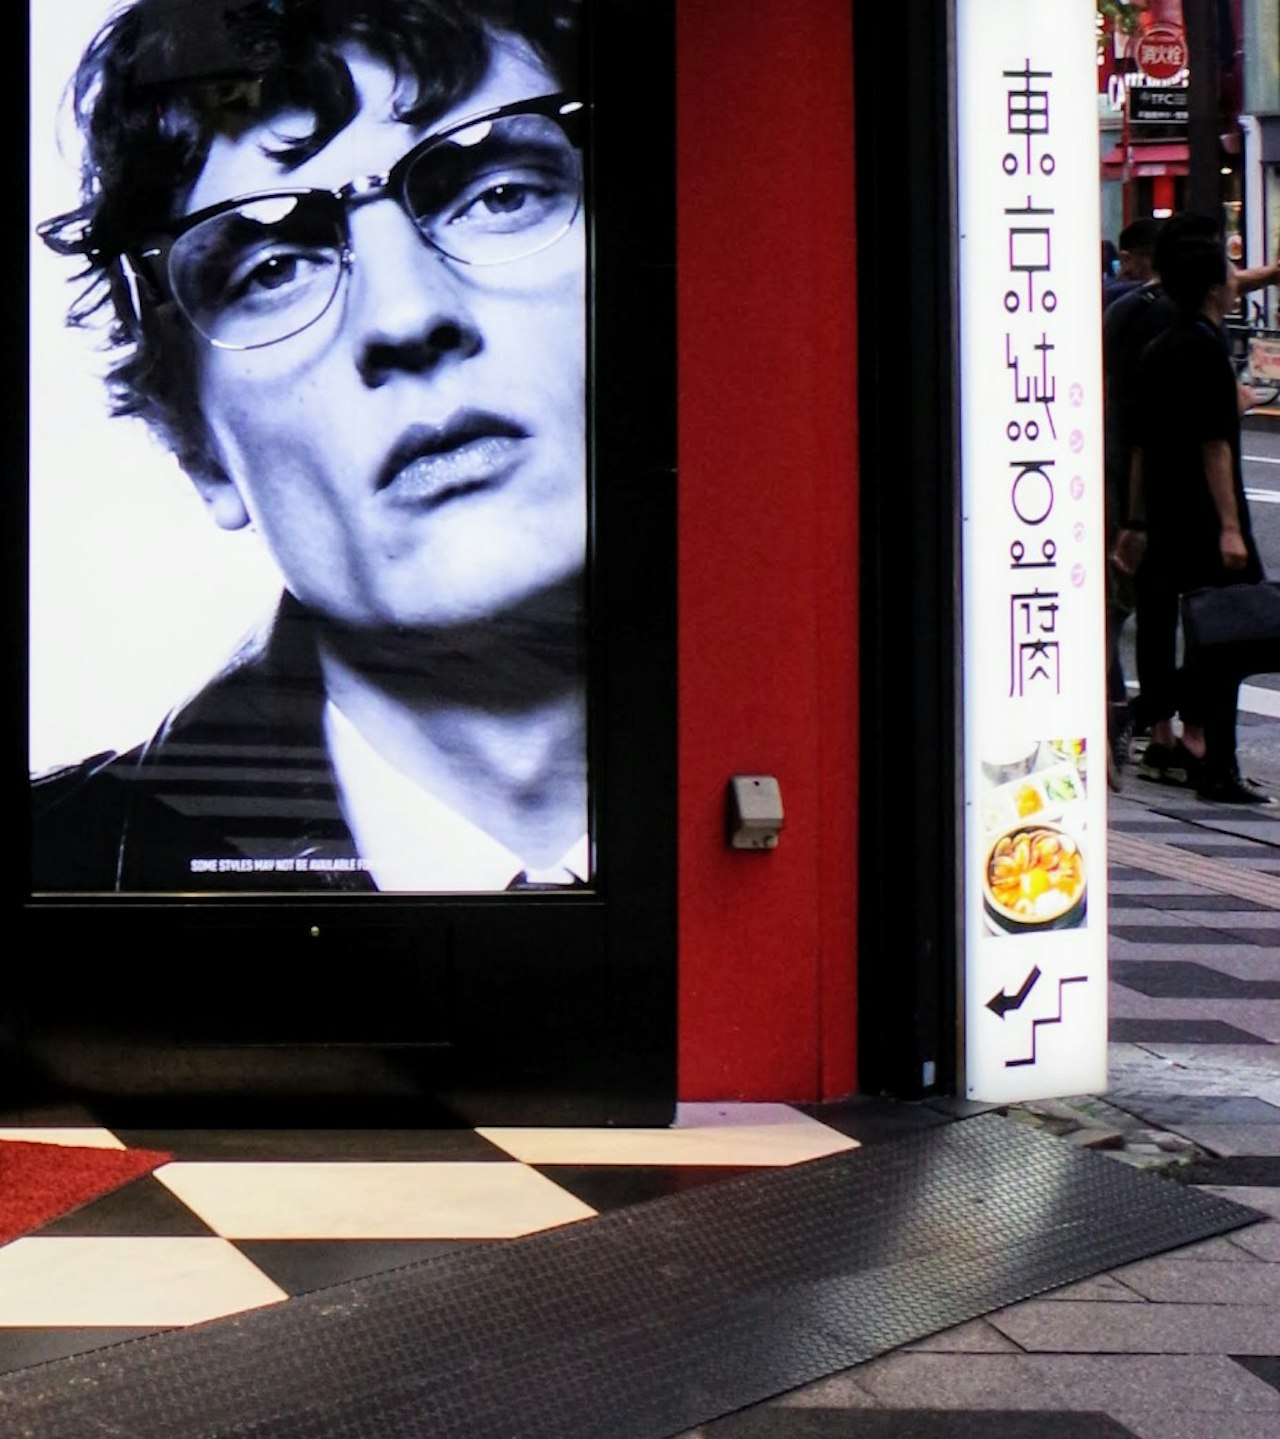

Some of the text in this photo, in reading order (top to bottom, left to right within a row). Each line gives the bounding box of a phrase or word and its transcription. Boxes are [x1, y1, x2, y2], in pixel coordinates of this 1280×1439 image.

[1141, 44, 1181, 64] 消火栓
[1002, 57, 1060, 698] 東京純豆腐
